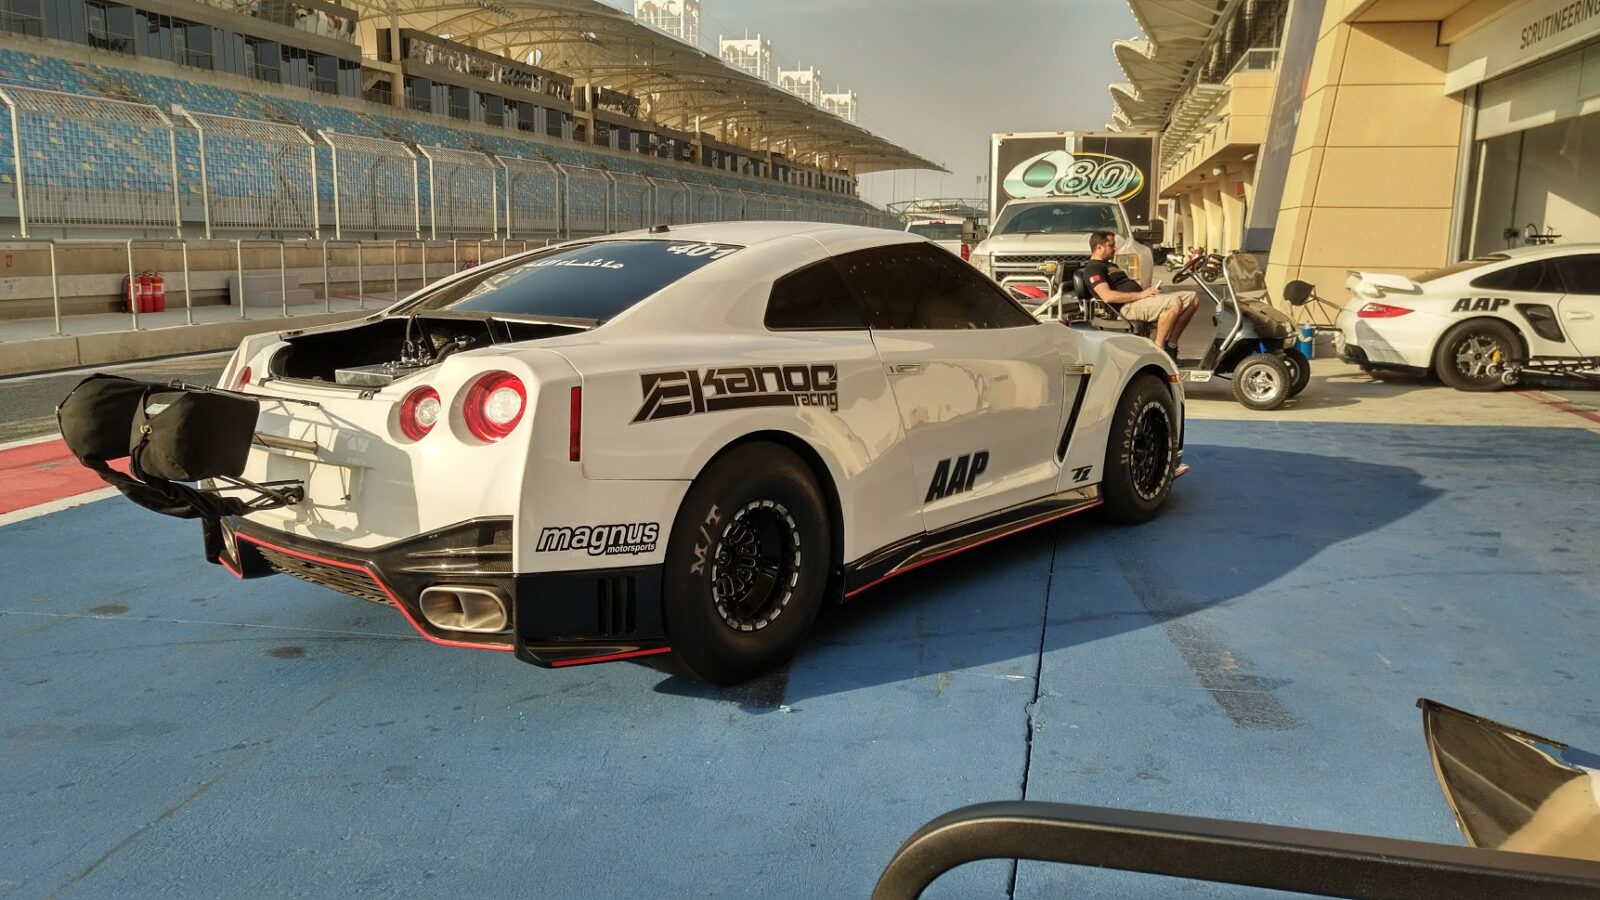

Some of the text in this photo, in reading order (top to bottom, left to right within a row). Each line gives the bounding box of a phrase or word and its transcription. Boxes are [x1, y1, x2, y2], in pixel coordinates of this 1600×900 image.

[1055, 158, 1136, 197] 80
[1451, 297, 1510, 312] AAP
[794, 392, 838, 412] racing
[924, 450, 989, 504] AAP
[536, 522, 660, 556] magnus
[606, 543, 656, 555] motorsports
